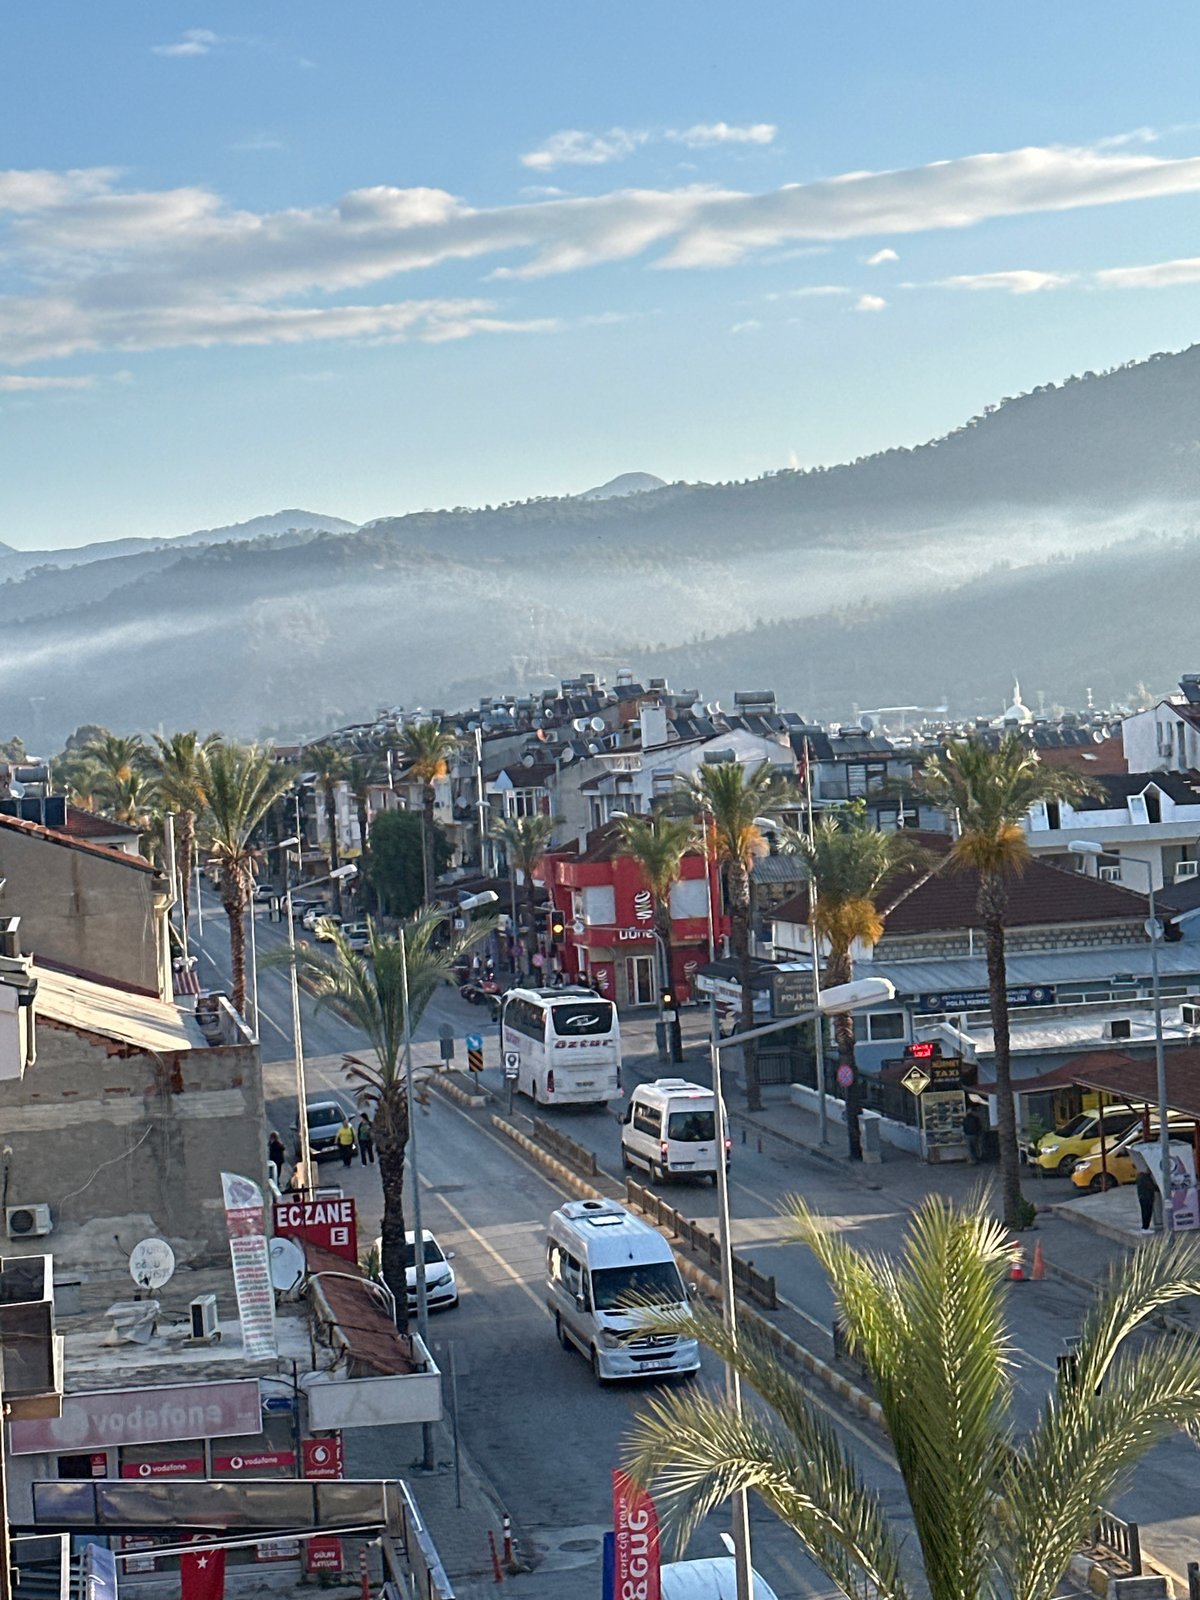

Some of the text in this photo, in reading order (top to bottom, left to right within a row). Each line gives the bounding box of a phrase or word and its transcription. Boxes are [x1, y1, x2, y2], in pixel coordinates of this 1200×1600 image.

[619, 926, 656, 940] Döne
[277, 1202, 353, 1227] ECZANE
[335, 1230, 345, 1242] E
[91, 1402, 223, 1433] vodafone
[244, 1456, 278, 1466] vodafone
[152, 1463, 188, 1473] vodafone
[306, 1468, 335, 1476] vodafone
